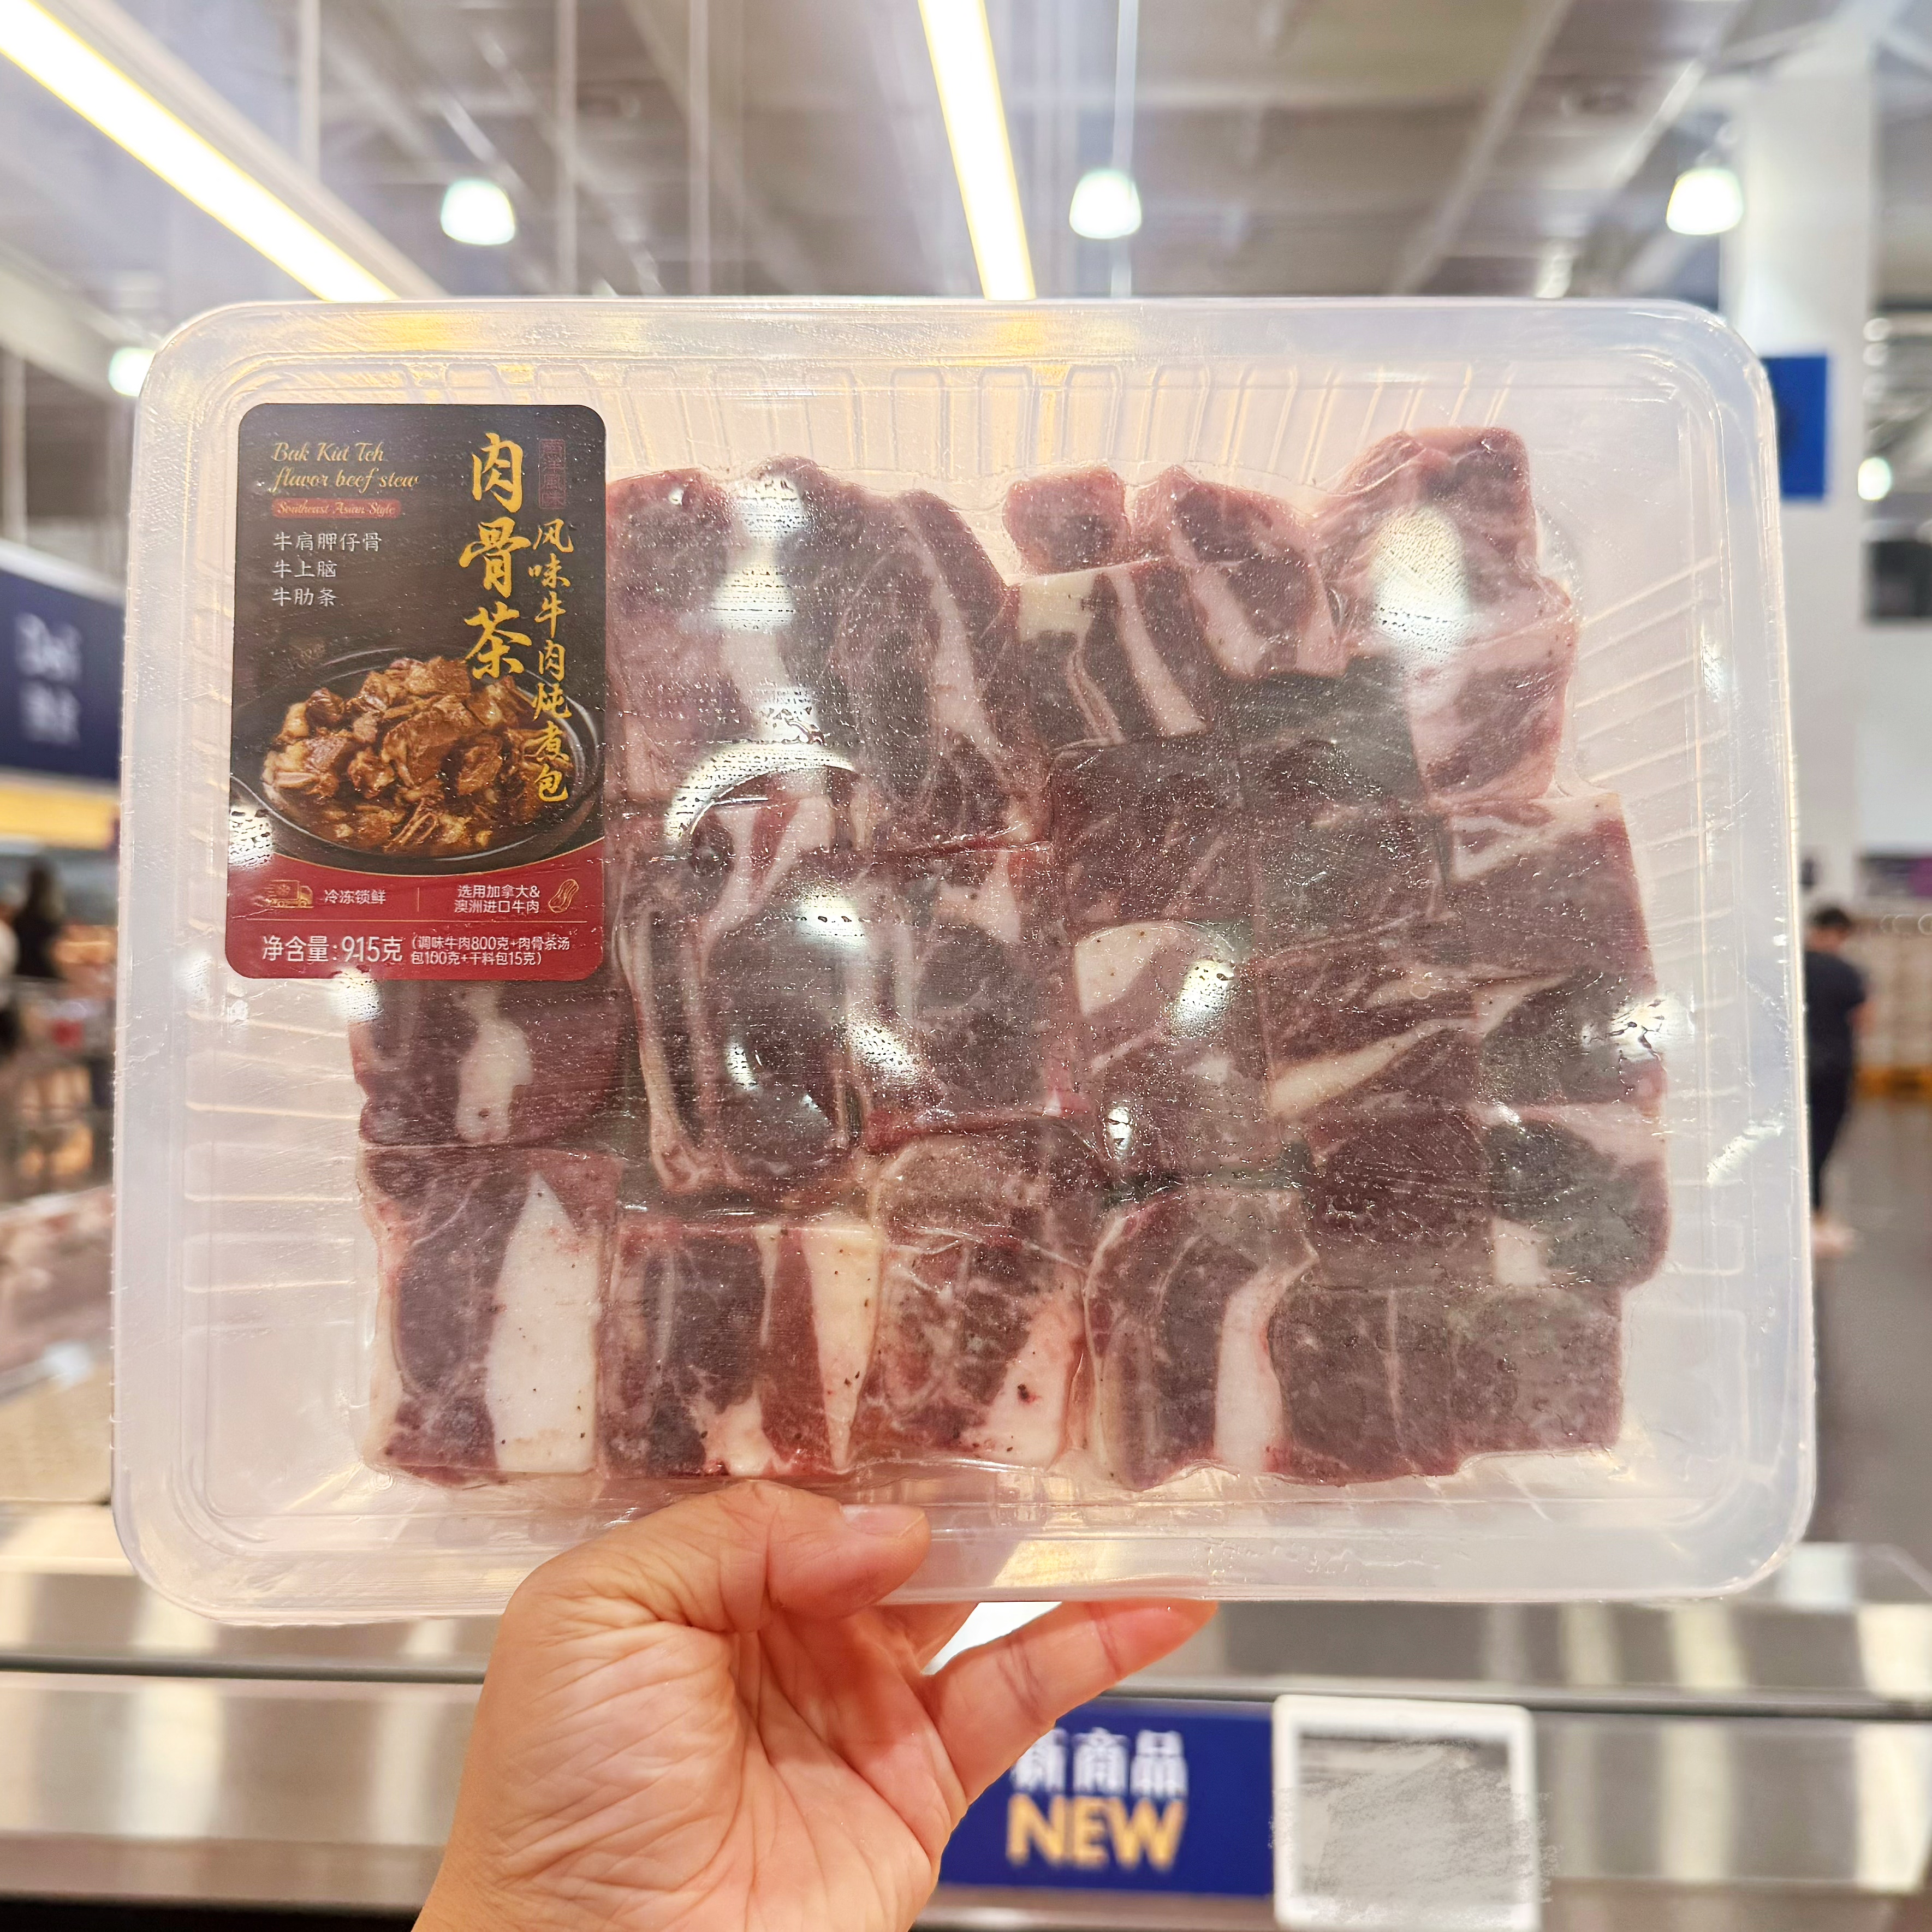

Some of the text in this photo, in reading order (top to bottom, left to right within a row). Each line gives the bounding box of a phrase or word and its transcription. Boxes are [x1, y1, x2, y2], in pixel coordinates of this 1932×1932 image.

[271, 442, 384, 461] Bak Kut Teh
[271, 466, 419, 493] flavor beef stew
[277, 501, 396, 517] Southeast Asian Style
[273, 531, 382, 552] 牛肩胛仔骨
[458, 432, 533, 680] 肉骨茶
[272, 559, 337, 579] 牛上脑
[272, 587, 339, 607] 牛肋条
[528, 518, 574, 802] 风味牛肉炖煮包
[324, 889, 387, 905] 冷冻锁鲜
[457, 884, 540, 899] 选用加拿大&
[454, 900, 540, 914] 澳洲进口牛肉
[1006, 1793, 1186, 1870] NEW
